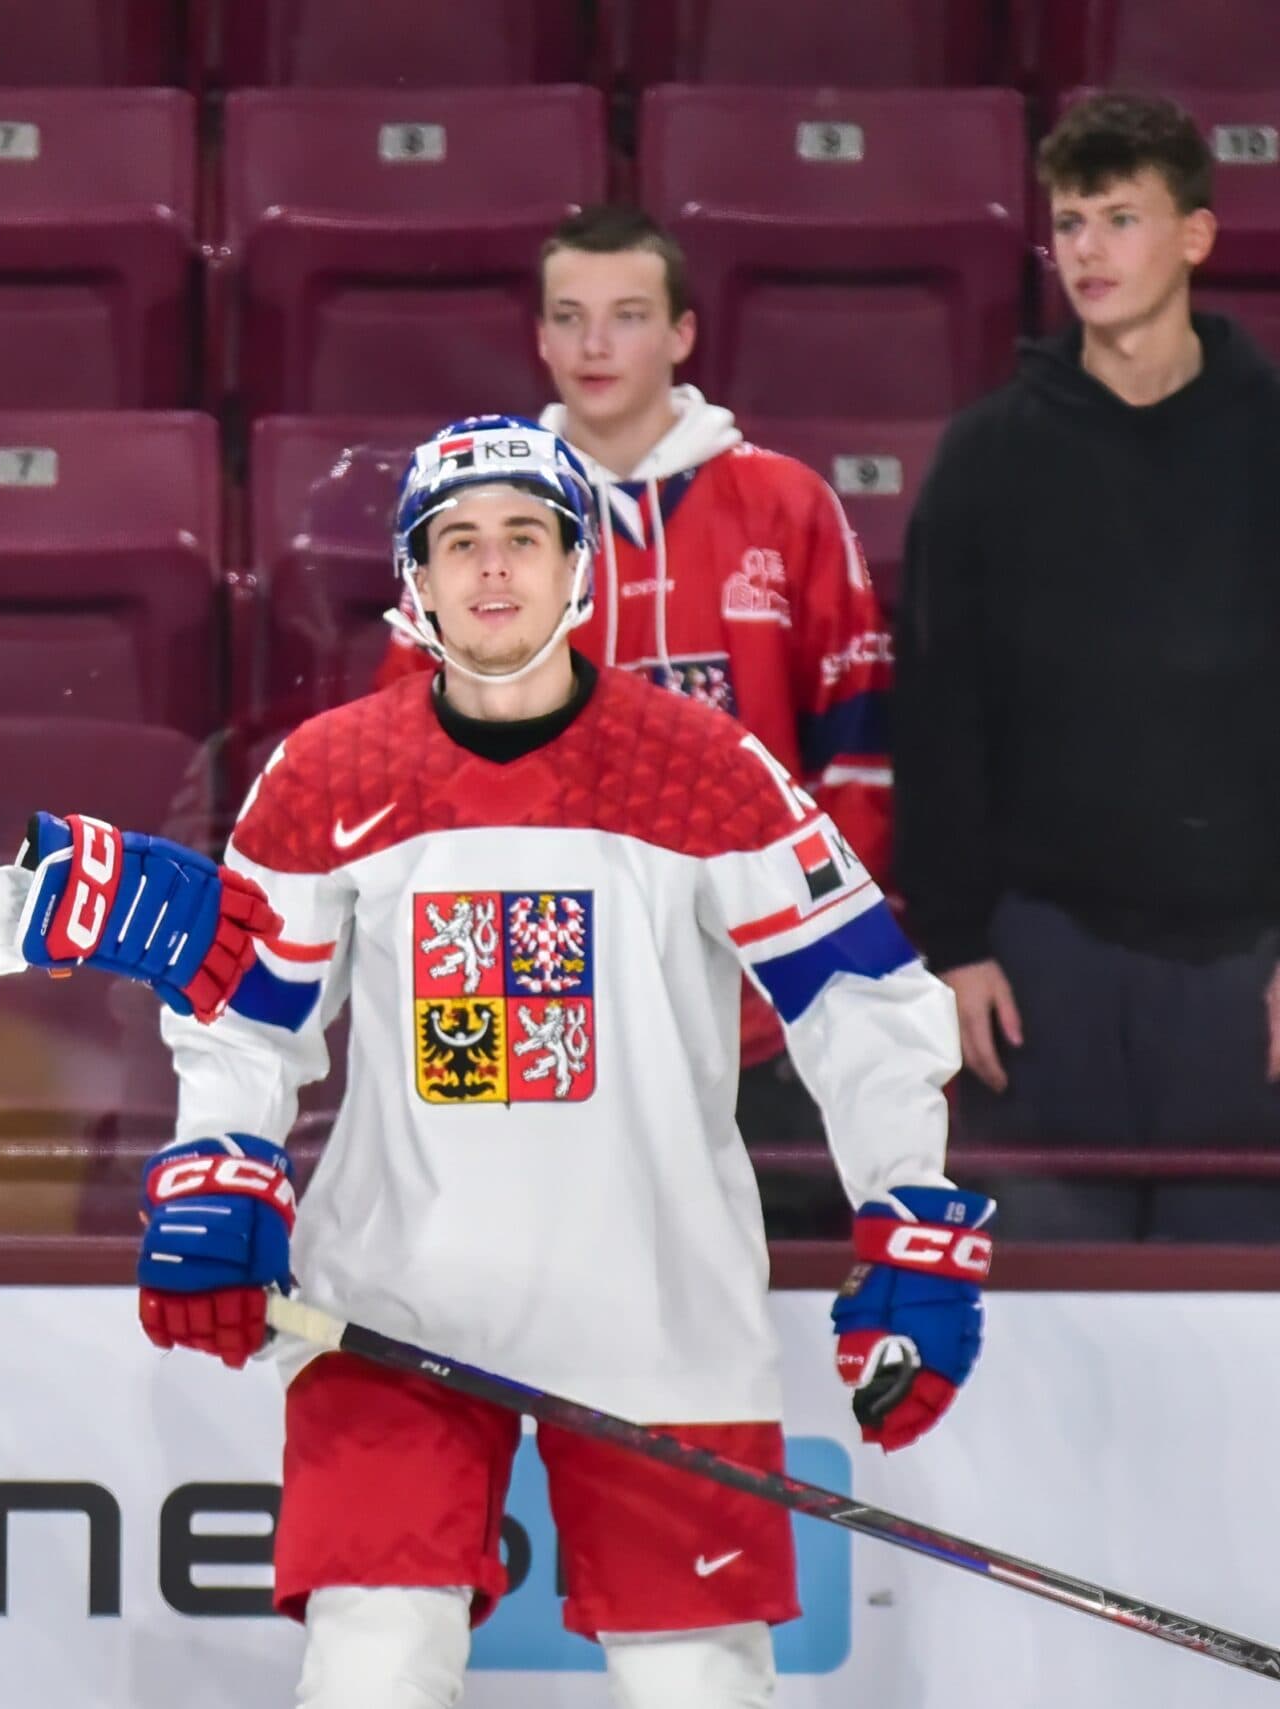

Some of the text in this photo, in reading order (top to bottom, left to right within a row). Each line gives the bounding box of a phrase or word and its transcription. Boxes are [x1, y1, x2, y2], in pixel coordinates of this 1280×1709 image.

[0, 124, 17, 150] 7
[1230, 130, 1267, 157] 10
[484, 439, 532, 460] KB
[16, 450, 34, 481] 7
[945, 1201, 966, 1223] 19
